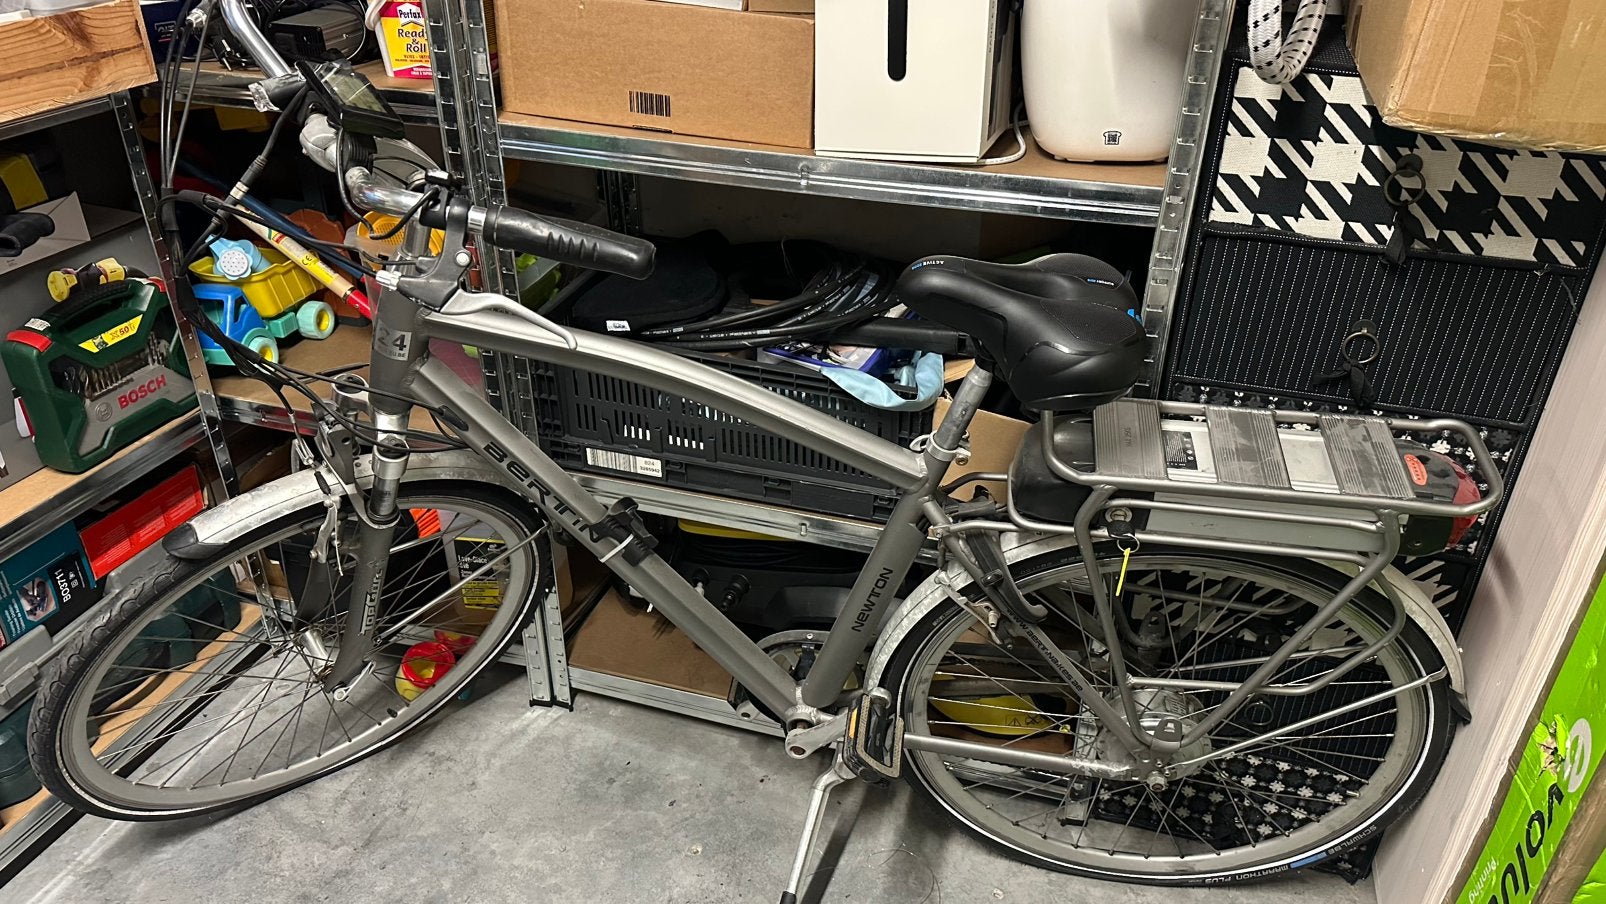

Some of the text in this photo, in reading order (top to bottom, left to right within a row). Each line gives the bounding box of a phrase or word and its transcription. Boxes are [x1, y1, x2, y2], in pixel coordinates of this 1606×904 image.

[398, 9, 422, 19] Perfax
[406, 43, 427, 53] Roll
[117, 374, 167, 410] BOSCH
[54, 568, 72, 602] BO3711
[1328, 824, 1377, 855] SCHWALBE
[1204, 864, 1289, 884] MARATHON PLUS
